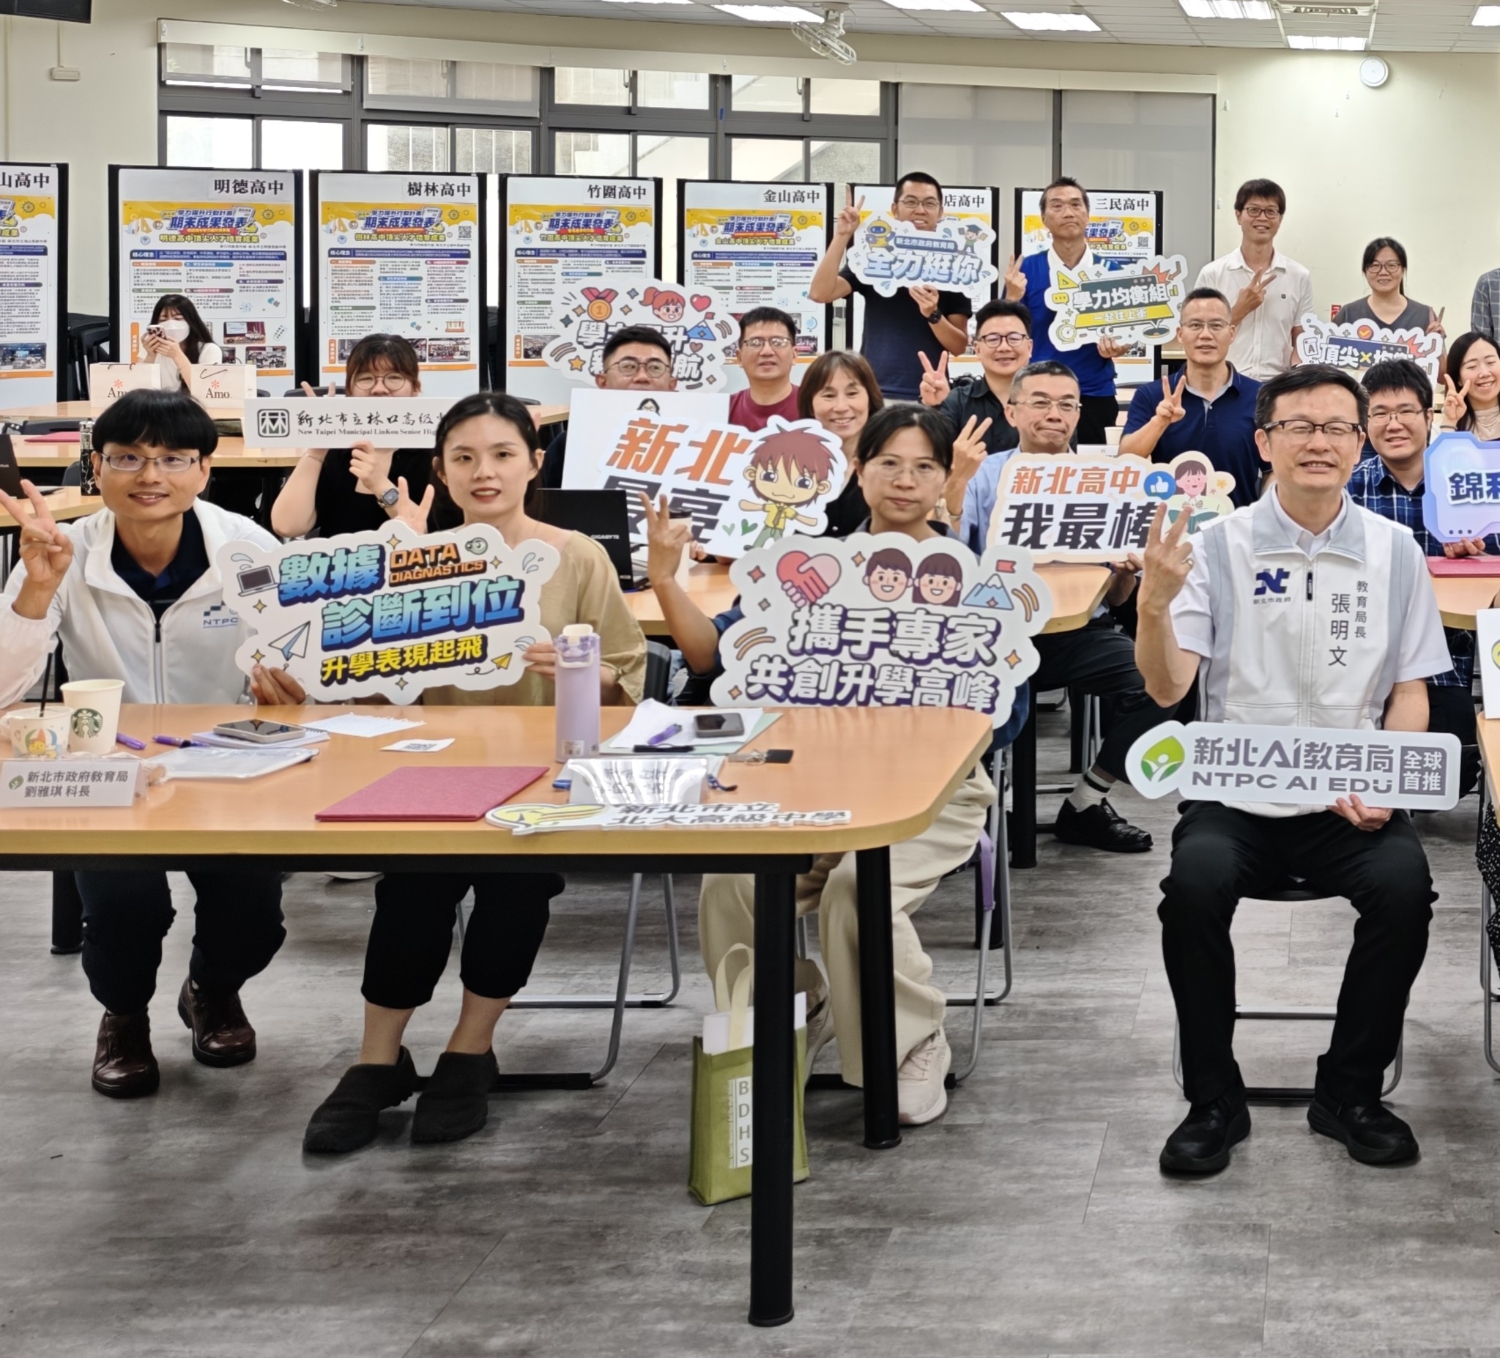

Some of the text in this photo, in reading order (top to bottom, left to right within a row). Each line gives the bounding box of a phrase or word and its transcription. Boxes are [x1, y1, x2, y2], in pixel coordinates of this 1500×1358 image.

[214, 179, 284, 195] 明德高中
[407, 182, 471, 197] 樹林高中
[587, 184, 647, 199] 竹圍高中
[763, 189, 820, 204] 金山高中
[944, 194, 985, 208] 店高中
[1095, 198, 1149, 211] 三民高中
[170, 217, 247, 228] 期末成果發表
[364, 217, 435, 228] 期末成果發表
[896, 238, 955, 250] 新北市政府教育局
[864, 250, 983, 284] 全力挺你
[1073, 284, 1169, 310] 學力均衡組
[577, 321, 689, 352] 學升
[315, 428, 336, 436] Taipei
[338, 428, 373, 436] Municipal
[605, 417, 753, 485] 新北
[1009, 465, 1141, 495] 新北高中
[1001, 501, 1160, 550] 我最棒
[390, 544, 459, 570] DATA
[278, 544, 384, 604] 數據
[390, 560, 485, 585] DIAGNASTICS
[322, 577, 524, 650] 診斷到位
[1355, 580, 1369, 639] 教育局長
[203, 617, 239, 625] NTPC
[1328, 593, 1351, 667] 張明文
[789, 604, 999, 667] 攜手專家
[321, 634, 486, 685] 升學表現起飛
[747, 656, 997, 713] 共創升學高峰
[1403, 751, 1442, 770] 全球
[27, 770, 129, 783] 新北市政府教育局
[1192, 772, 1393, 793] NTPC AI EDU
[1403, 772, 1442, 791] 首推
[65, 785, 91, 797] 科長
[607, 811, 846, 825] 北大高級中學
[616, 803, 778, 814] 新北市立
